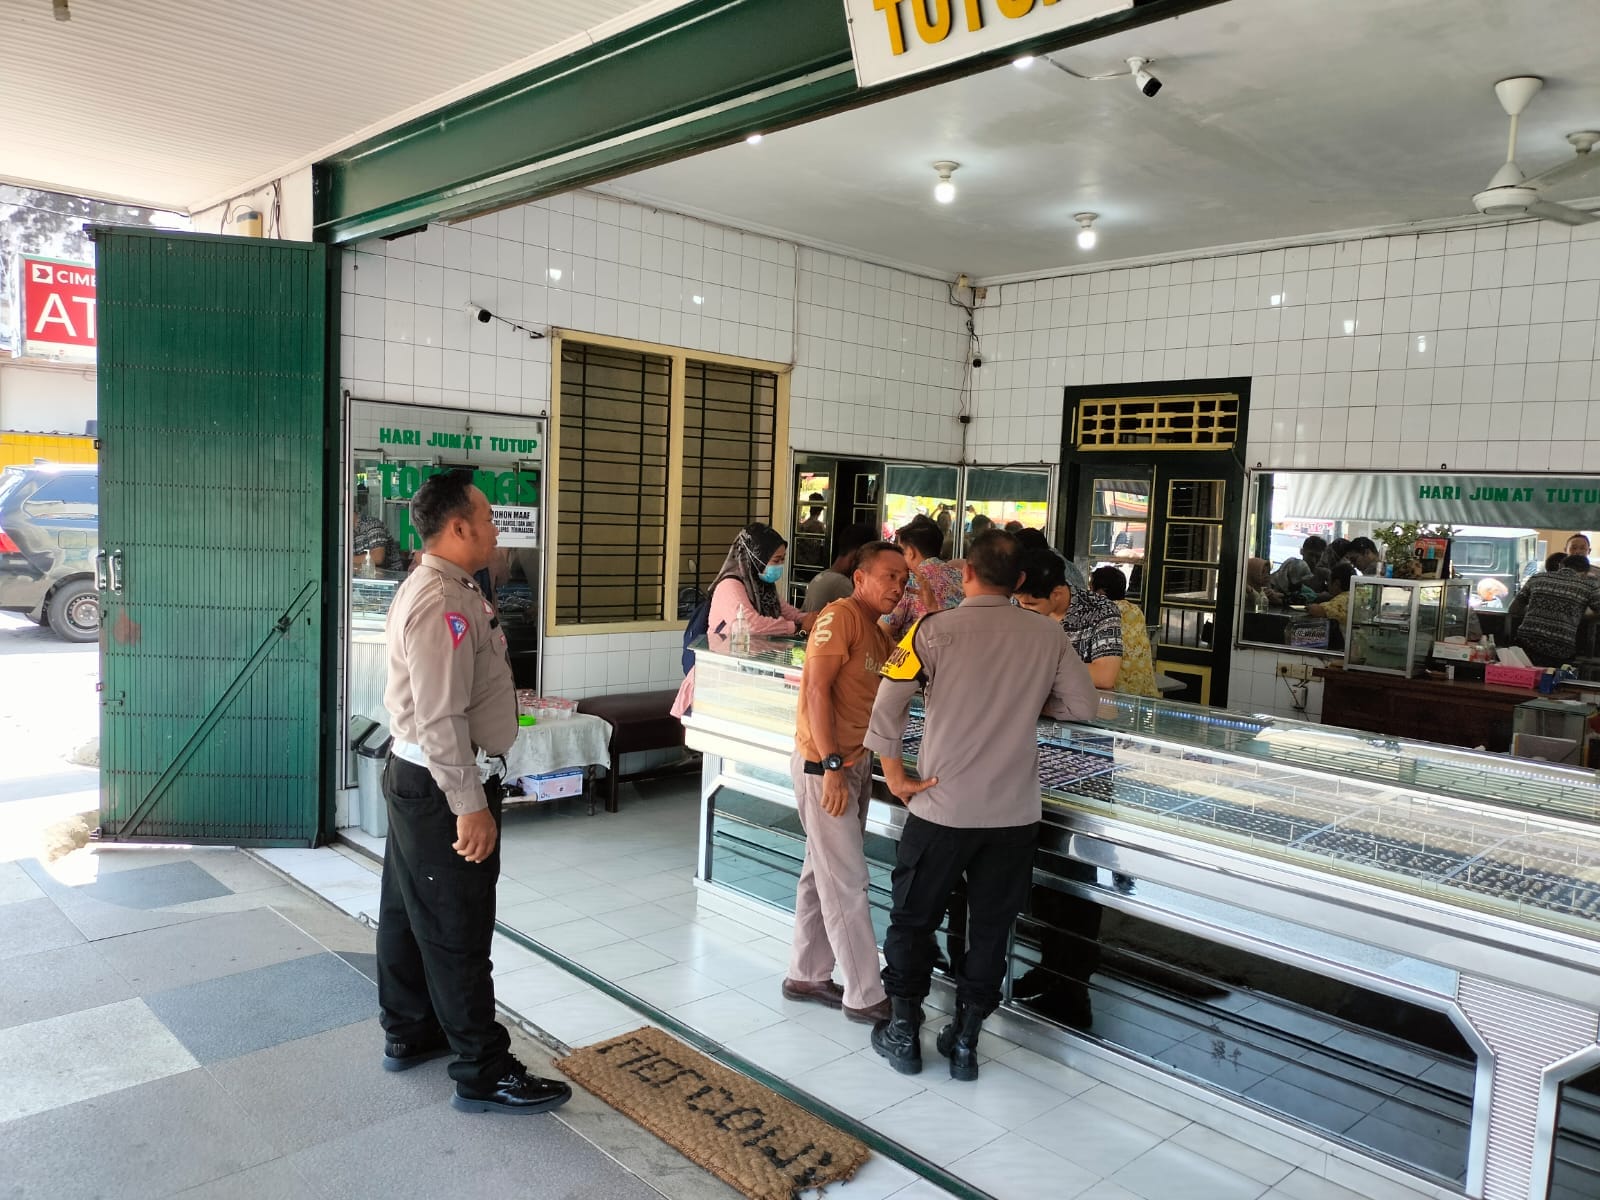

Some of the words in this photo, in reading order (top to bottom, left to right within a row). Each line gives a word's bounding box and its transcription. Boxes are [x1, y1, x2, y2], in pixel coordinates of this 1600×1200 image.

[379, 427, 421, 446] HARI
[489, 436, 538, 453] TUTUP
[1419, 485, 1461, 500] HARI
[1545, 488, 1600, 503] TUTU
